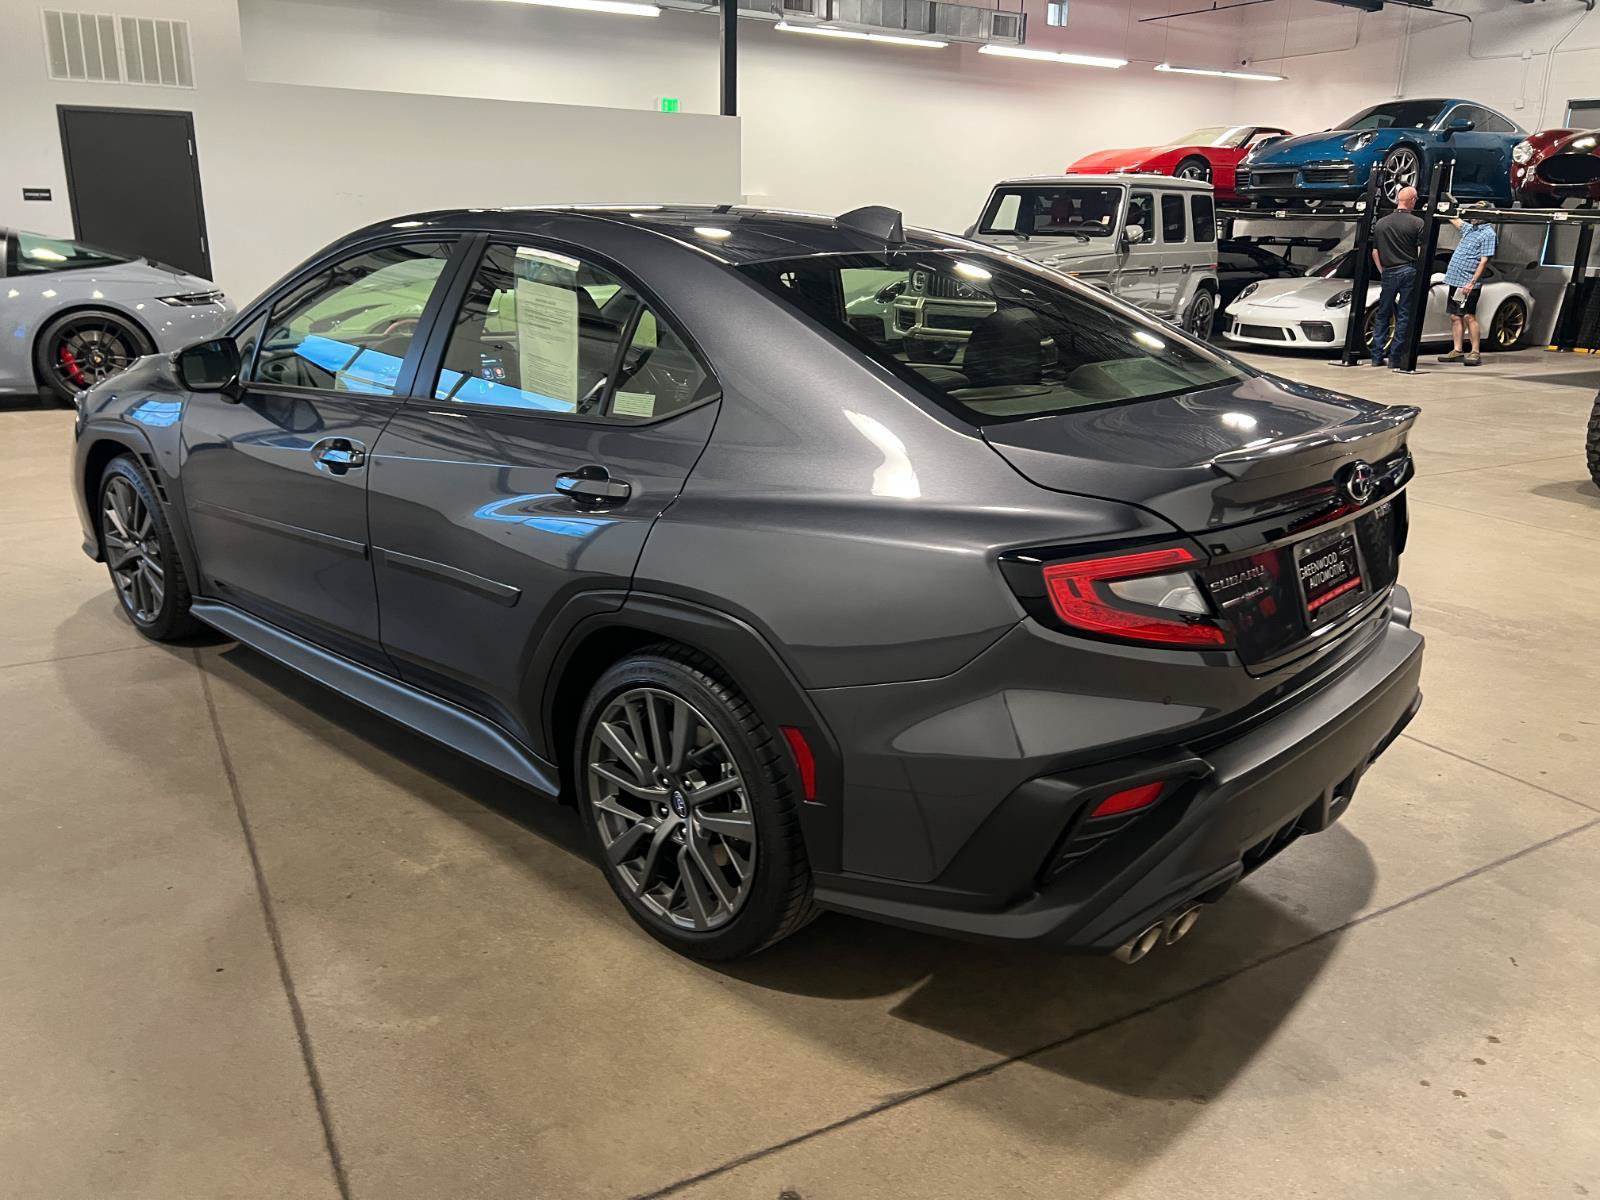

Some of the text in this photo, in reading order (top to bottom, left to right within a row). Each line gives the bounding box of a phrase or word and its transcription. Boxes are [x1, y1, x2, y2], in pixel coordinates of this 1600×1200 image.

[1370, 188, 1382, 233] ATLAS
[1209, 564, 1264, 593] SUBARU
[1299, 551, 1338, 579] GREENWOOD
[1310, 560, 1345, 589] AUTOMOTIVE
